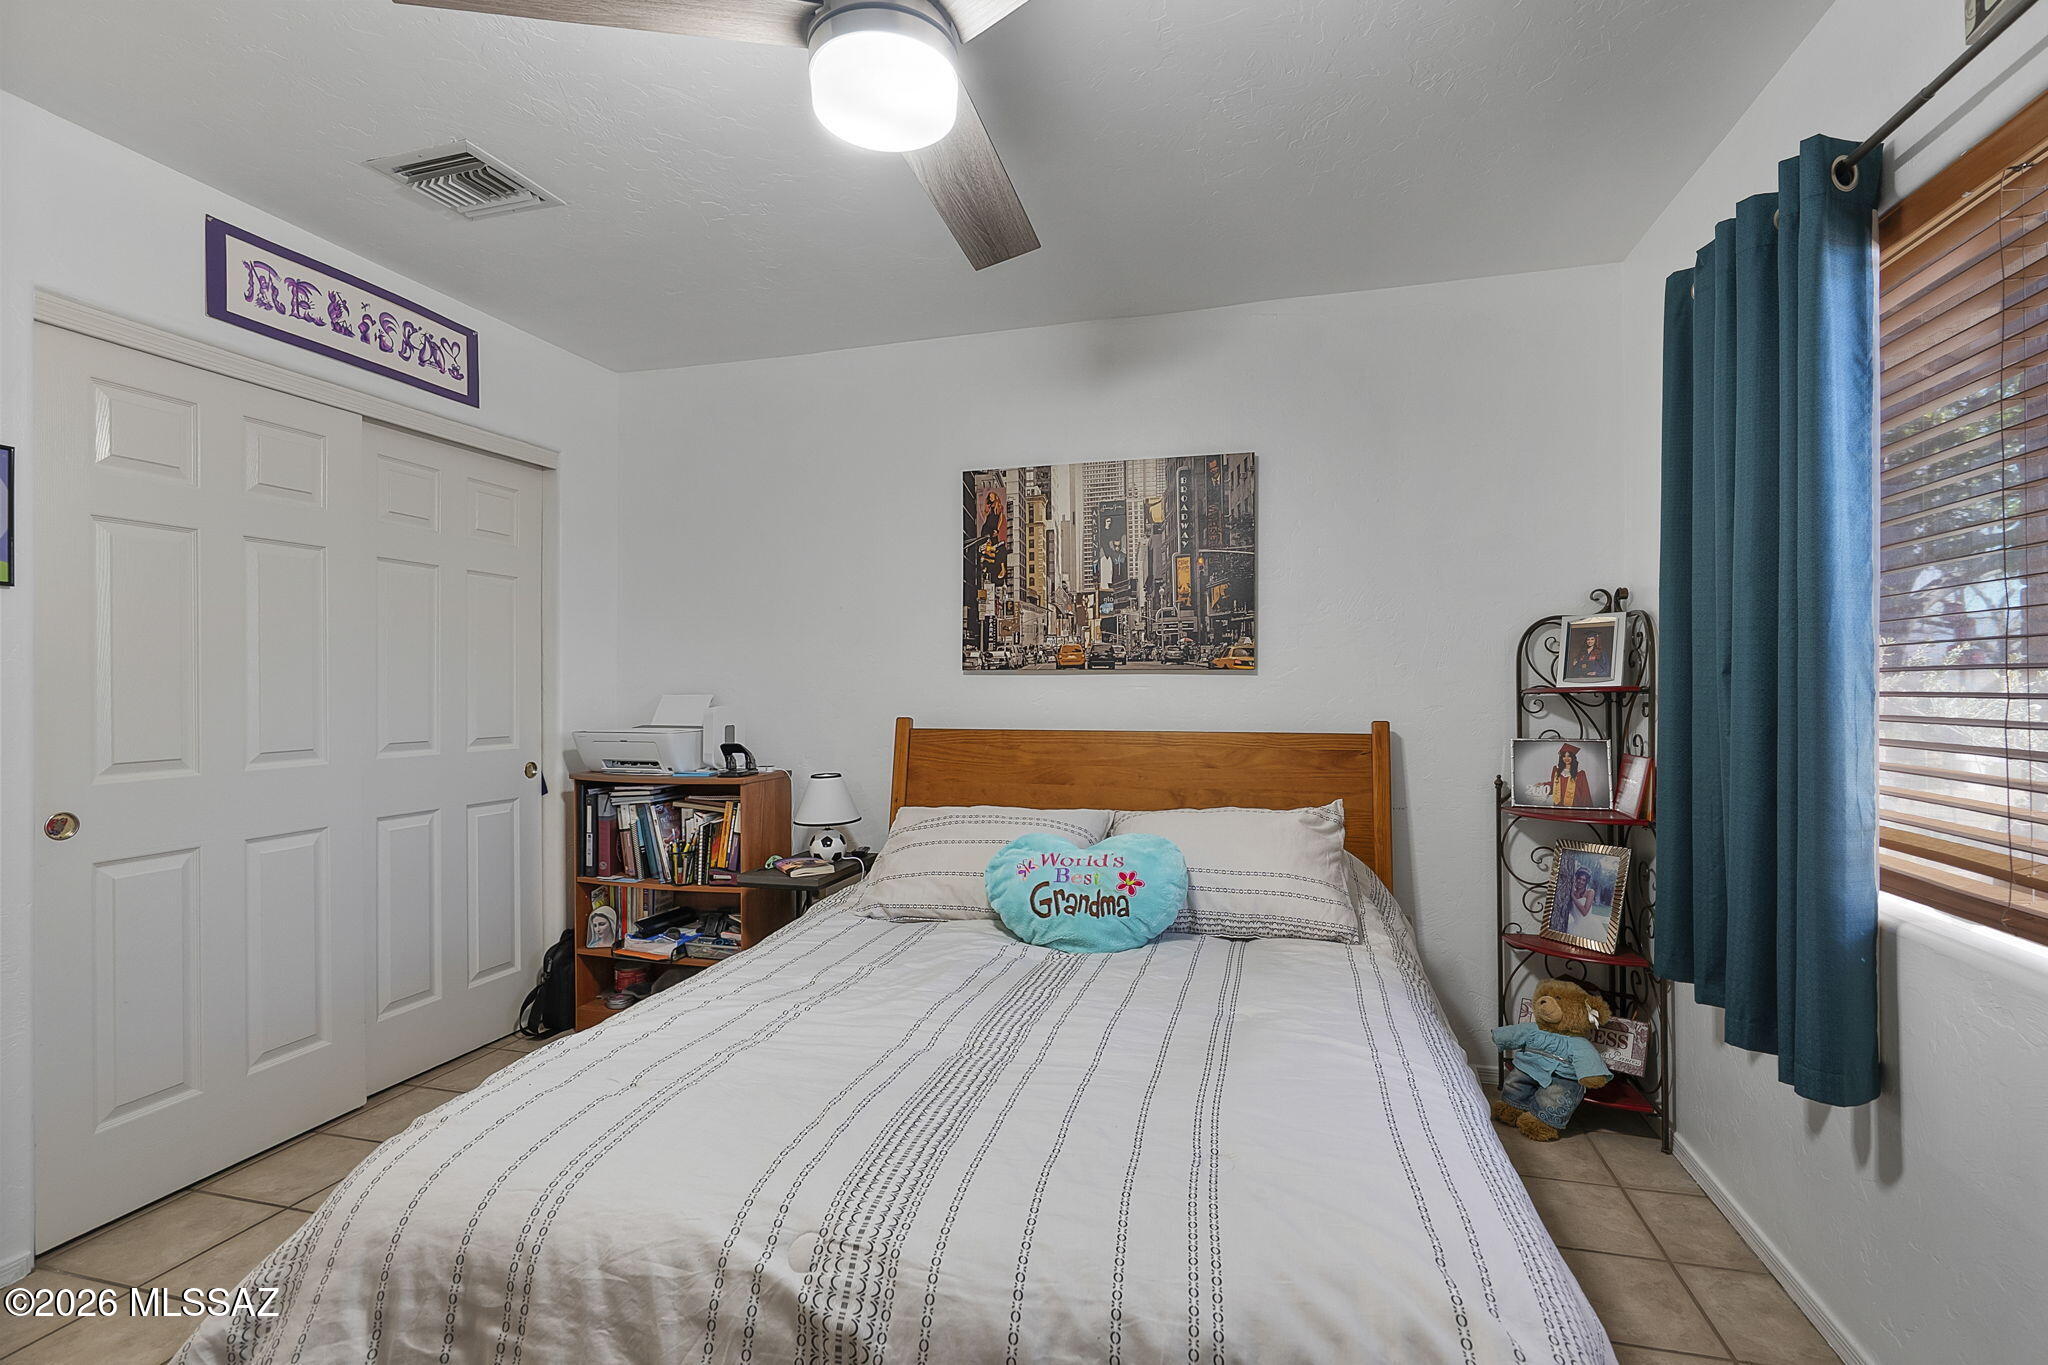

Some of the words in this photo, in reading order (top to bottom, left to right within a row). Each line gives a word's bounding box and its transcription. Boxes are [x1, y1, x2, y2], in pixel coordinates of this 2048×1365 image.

[1179, 475, 1189, 549] BROADWAY
[1041, 852, 1125, 868] World's
[1053, 867, 1099, 885] Best
[1029, 880, 1131, 919] Grandma
